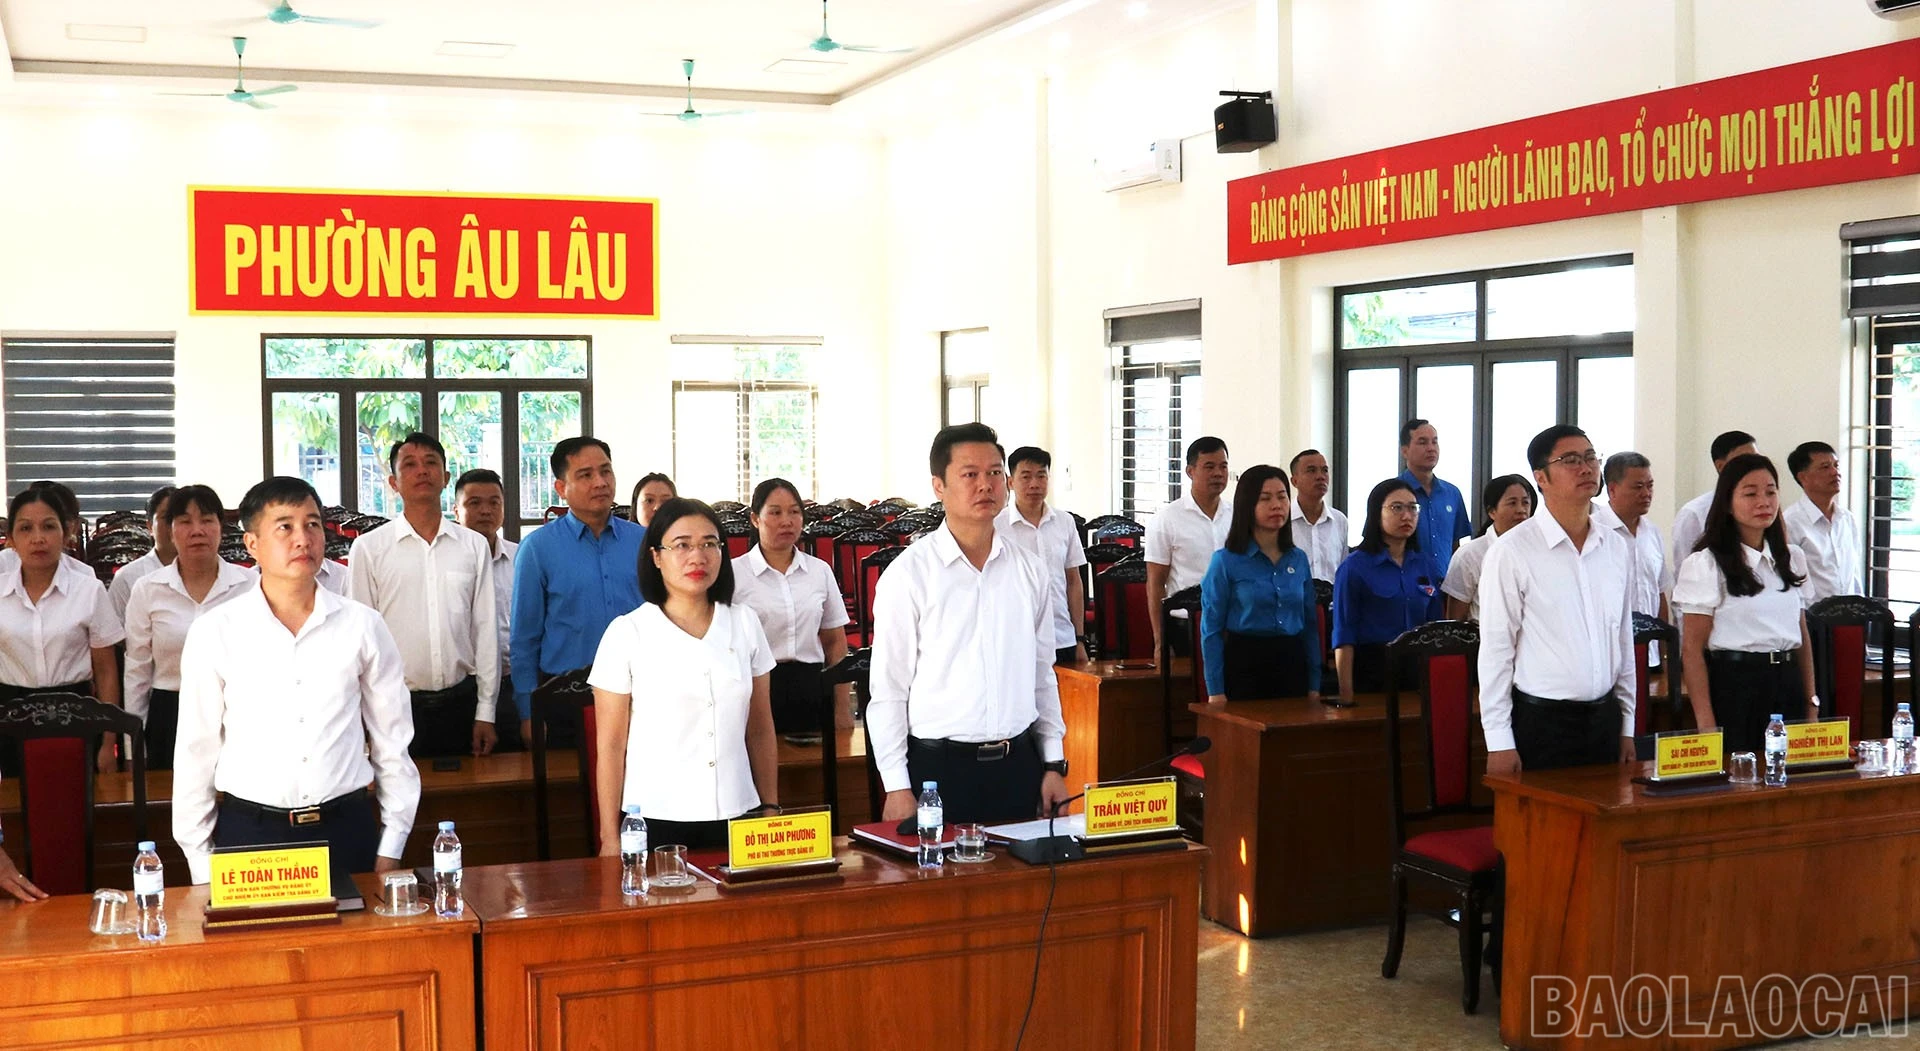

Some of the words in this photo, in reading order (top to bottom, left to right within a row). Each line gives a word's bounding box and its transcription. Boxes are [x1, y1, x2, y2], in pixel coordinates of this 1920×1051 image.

[1251, 185, 1286, 244] ĐẢNG
[1290, 183, 1326, 246] CỘNG
[1331, 169, 1360, 232] SẢN
[1364, 168, 1396, 235] VIỆT
[1401, 168, 1438, 221] NAM
[1454, 144, 1508, 213] NGƯỜI
[1514, 140, 1562, 204] LÃNH
[1568, 136, 1614, 206] ĐẠO,
[1620, 106, 1646, 188] TỔ
[1652, 108, 1712, 184] CHỨC
[1720, 108, 1766, 184] MỌI
[1774, 74, 1862, 166] THẮNG
[1870, 76, 1914, 164] LỢI
[224, 208, 436, 299] PHƯỜNG
[454, 213, 519, 299] ÂU
[538, 216, 626, 300] LÂU
[1124, 799, 1145, 816] VIỆT
[1148, 796, 1168, 813] QUÝ
[757, 833, 768, 846] THỊ
[770, 831, 784, 844] LAN
[786, 828, 816, 842] PHƯƠNG
[222, 868, 236, 885] LÊ
[240, 866, 273, 883] TOÀN
[277, 862, 319, 881] THẮNG
